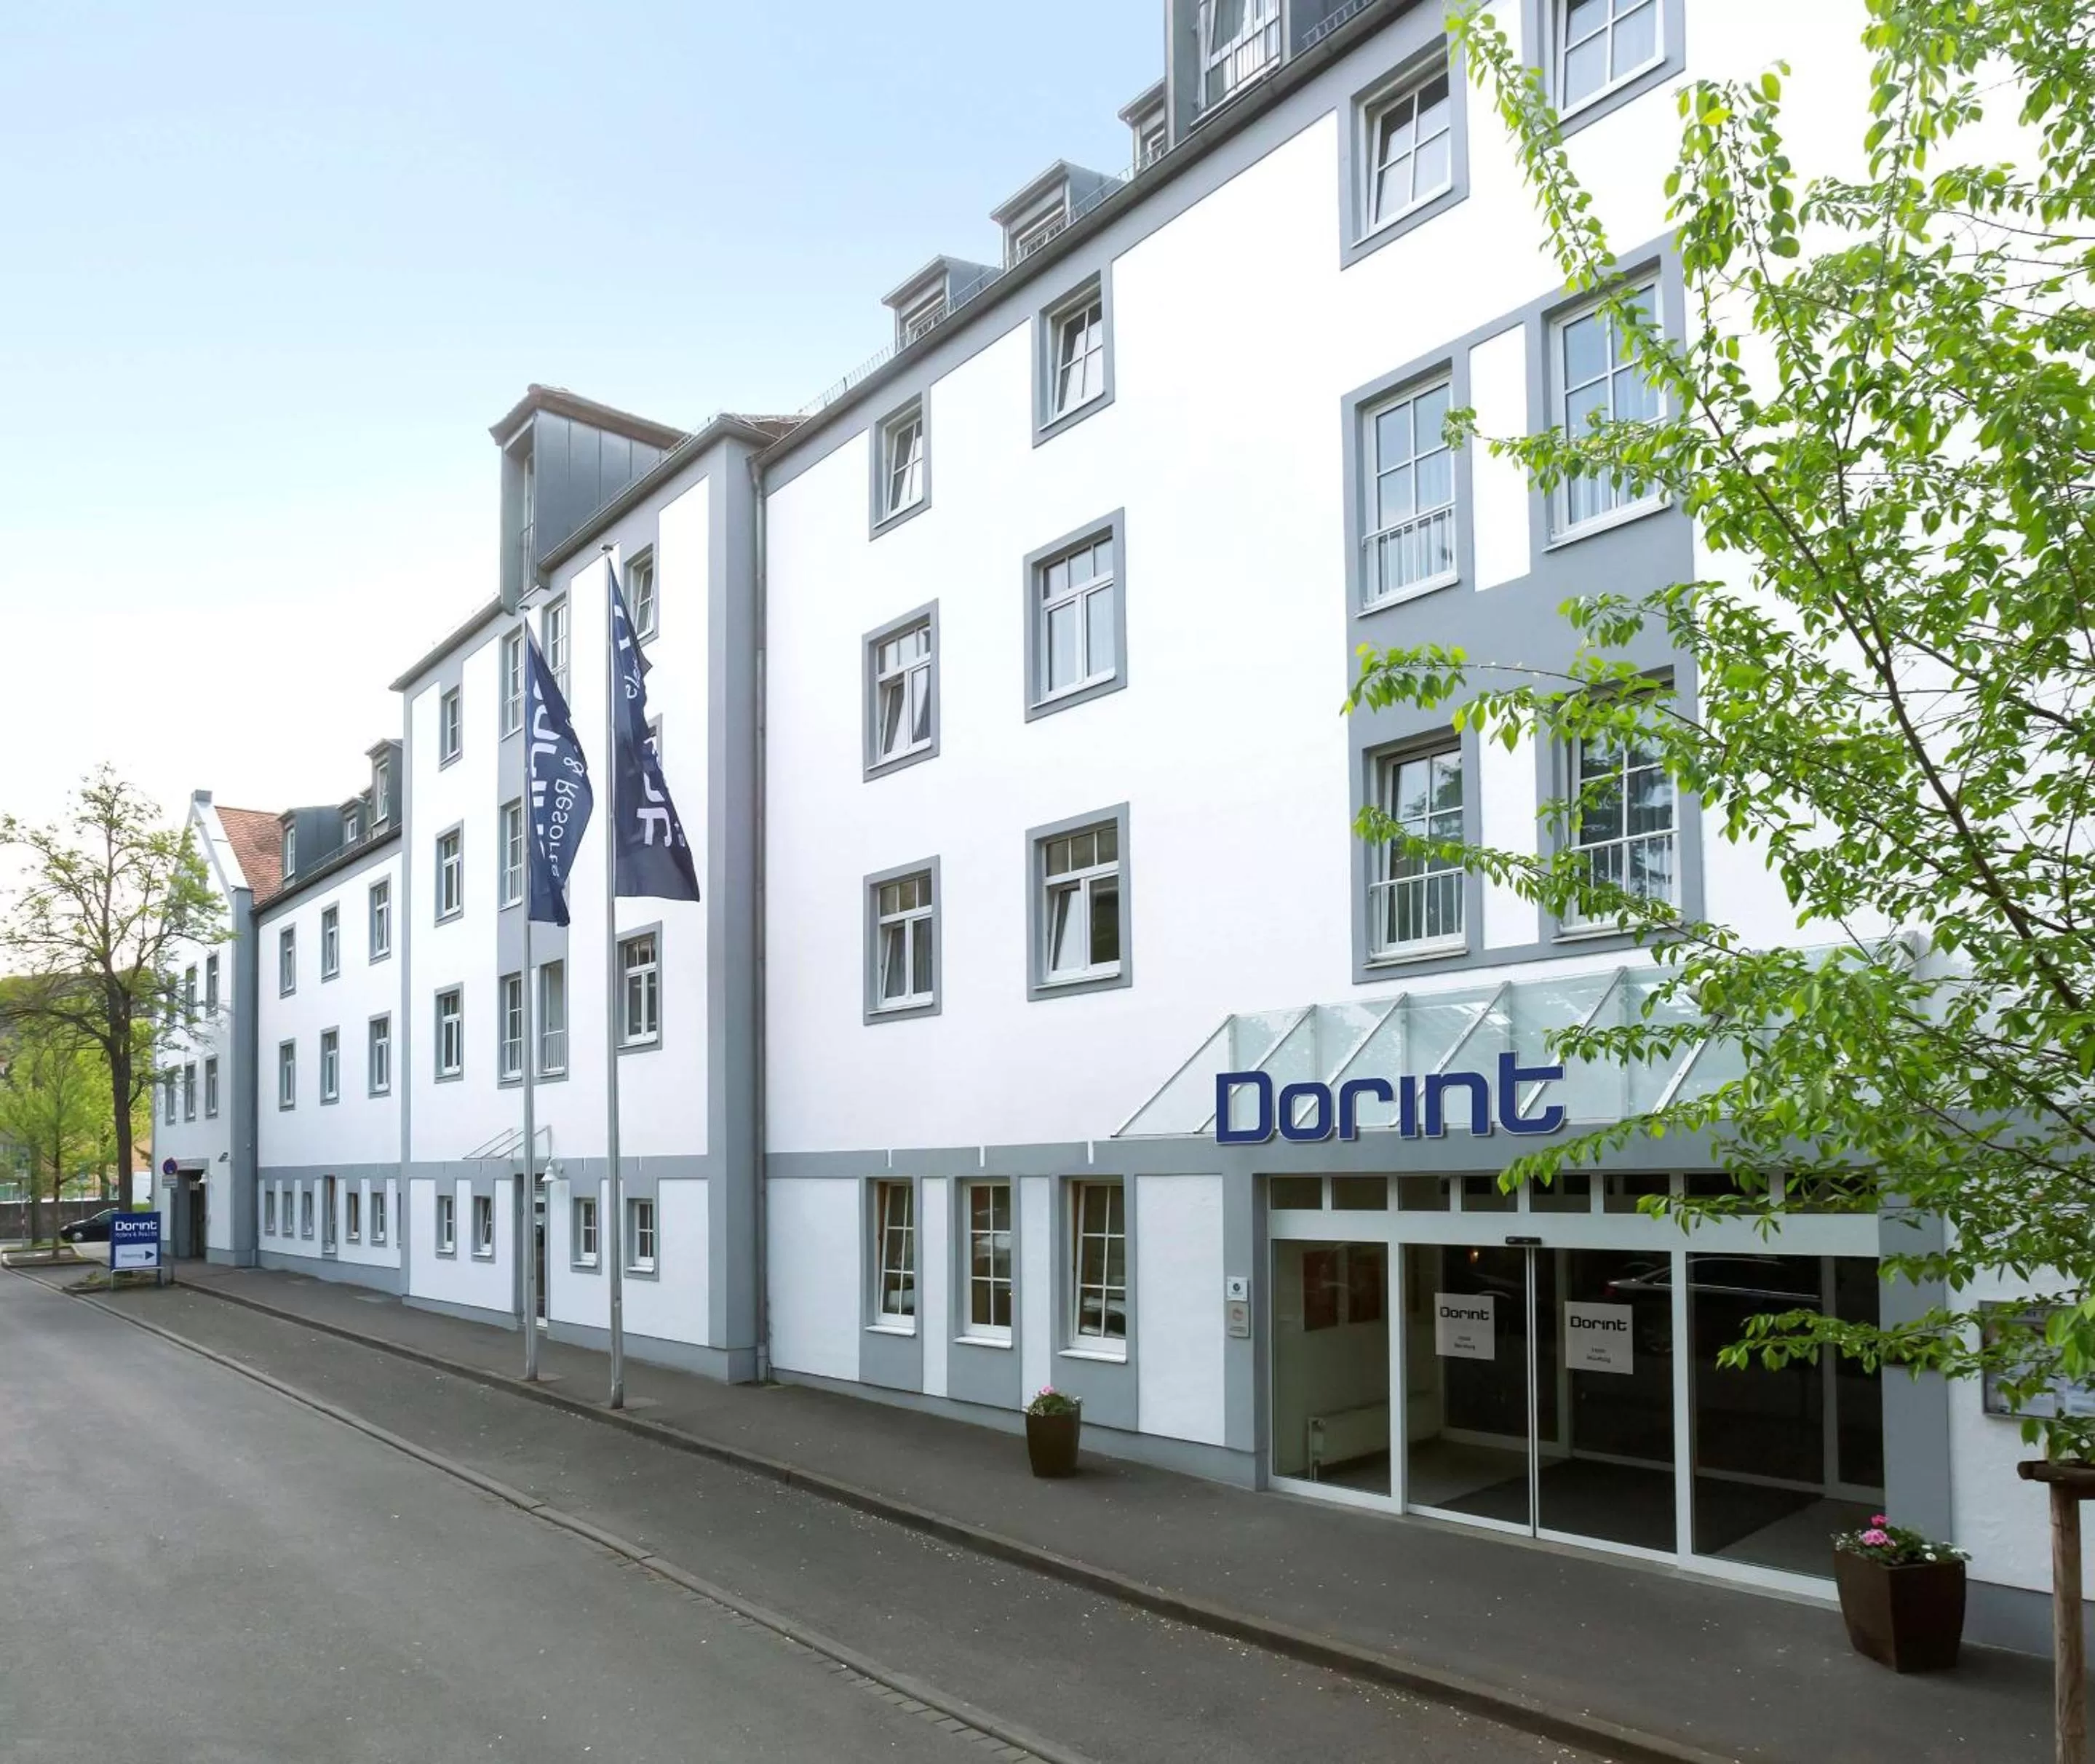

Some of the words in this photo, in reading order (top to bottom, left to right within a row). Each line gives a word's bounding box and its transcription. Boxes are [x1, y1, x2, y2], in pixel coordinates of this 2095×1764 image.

[1215, 1050, 1565, 1145] Dorint
[115, 1220, 157, 1231] Dorint
[1440, 1306, 1490, 1321] Dorint
[1570, 1315, 1627, 1331] Dorint
